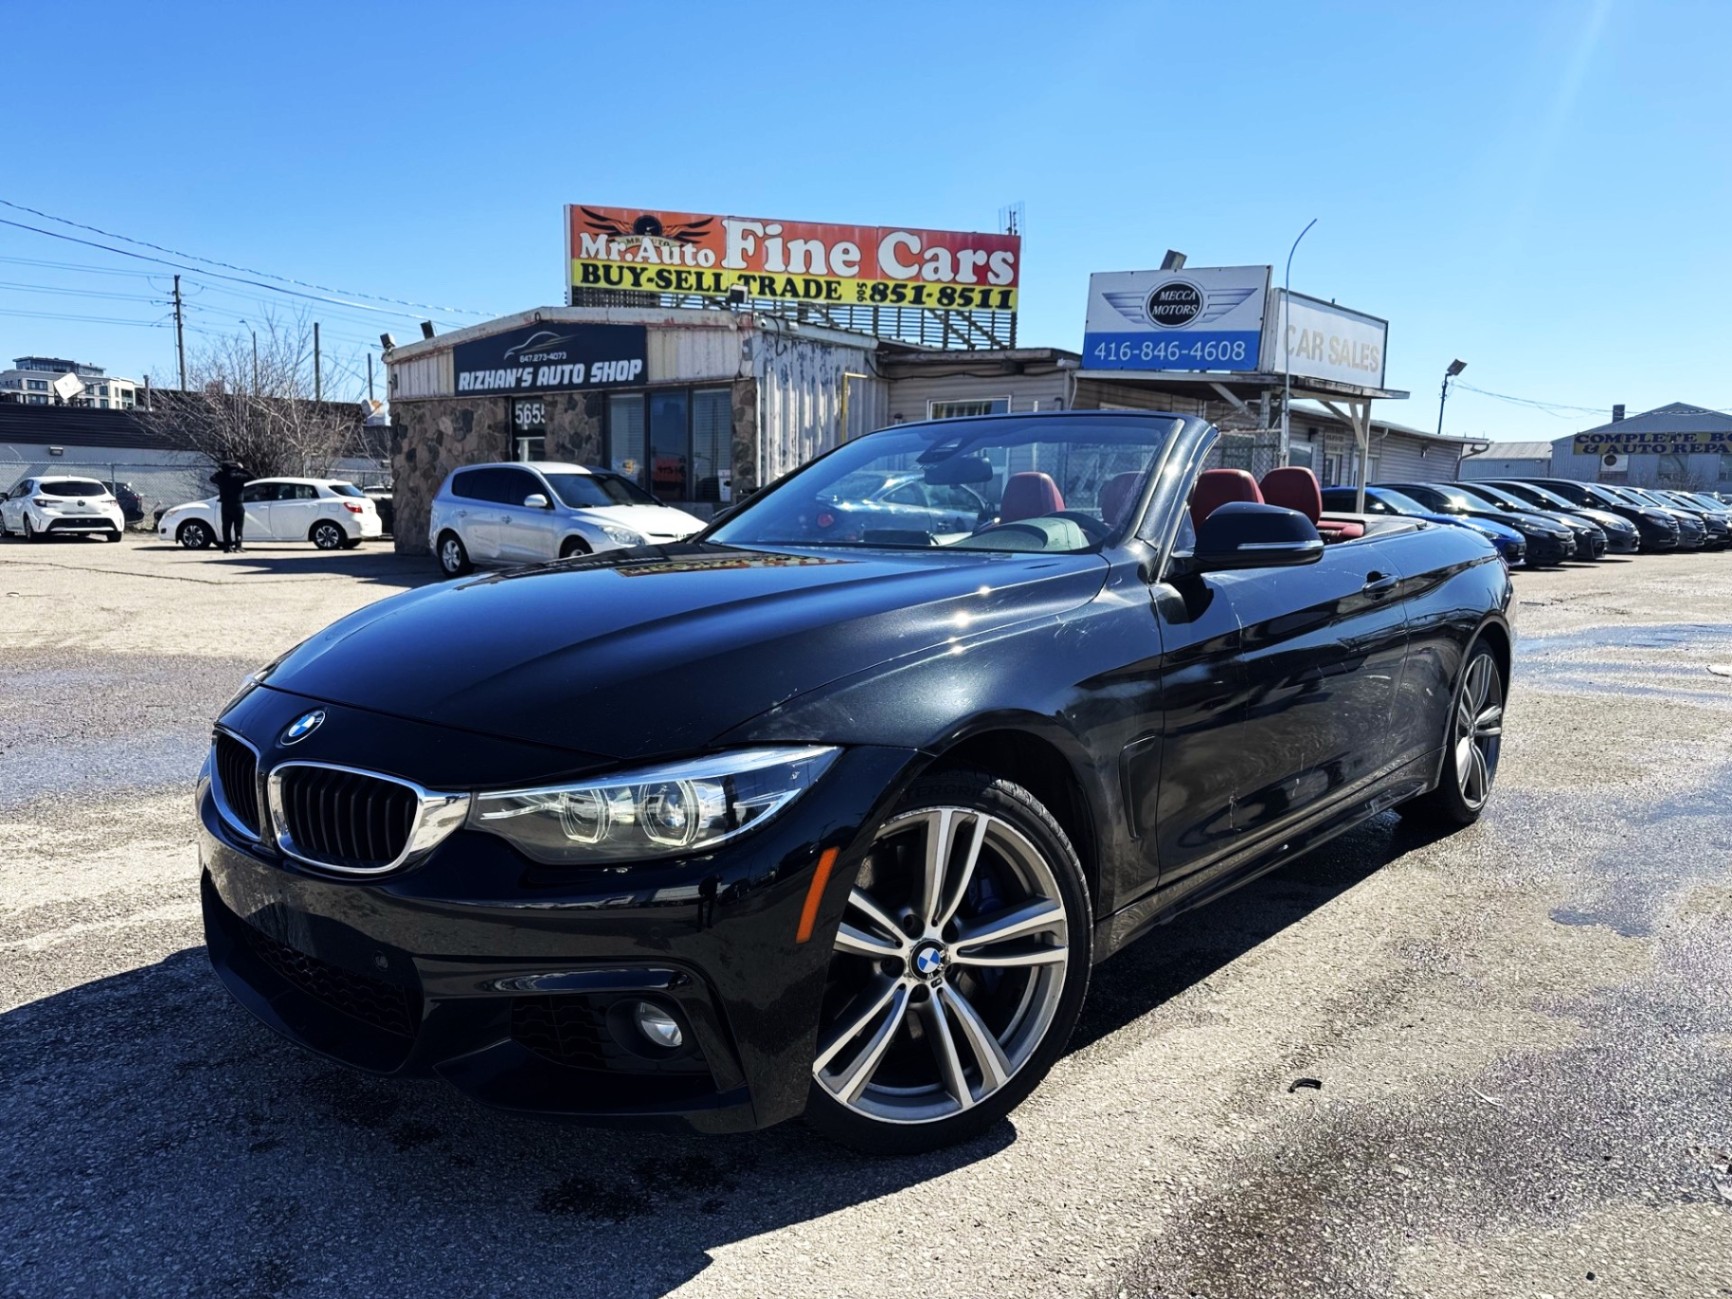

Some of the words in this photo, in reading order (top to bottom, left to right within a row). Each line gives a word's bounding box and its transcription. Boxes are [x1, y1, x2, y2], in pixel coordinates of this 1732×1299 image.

[580, 232, 716, 268] Mr.Auto
[722, 220, 861, 277] Fine
[877, 230, 1015, 285] Cars
[869, 282, 1014, 309] 851-8511
[1158, 290, 1197, 301] MECCA
[1152, 304, 1198, 316] MOTORS
[1094, 341, 1246, 361] 416-846-4608
[1284, 325, 1324, 361] CAR
[1328, 335, 1379, 373] SALES
[458, 366, 534, 391] RIZHAN'S
[536, 363, 585, 386] AUTO
[590, 359, 643, 383] SHOP
[1575, 432, 1697, 443] COMPLETE
[1605, 443, 1667, 454] AUTO
